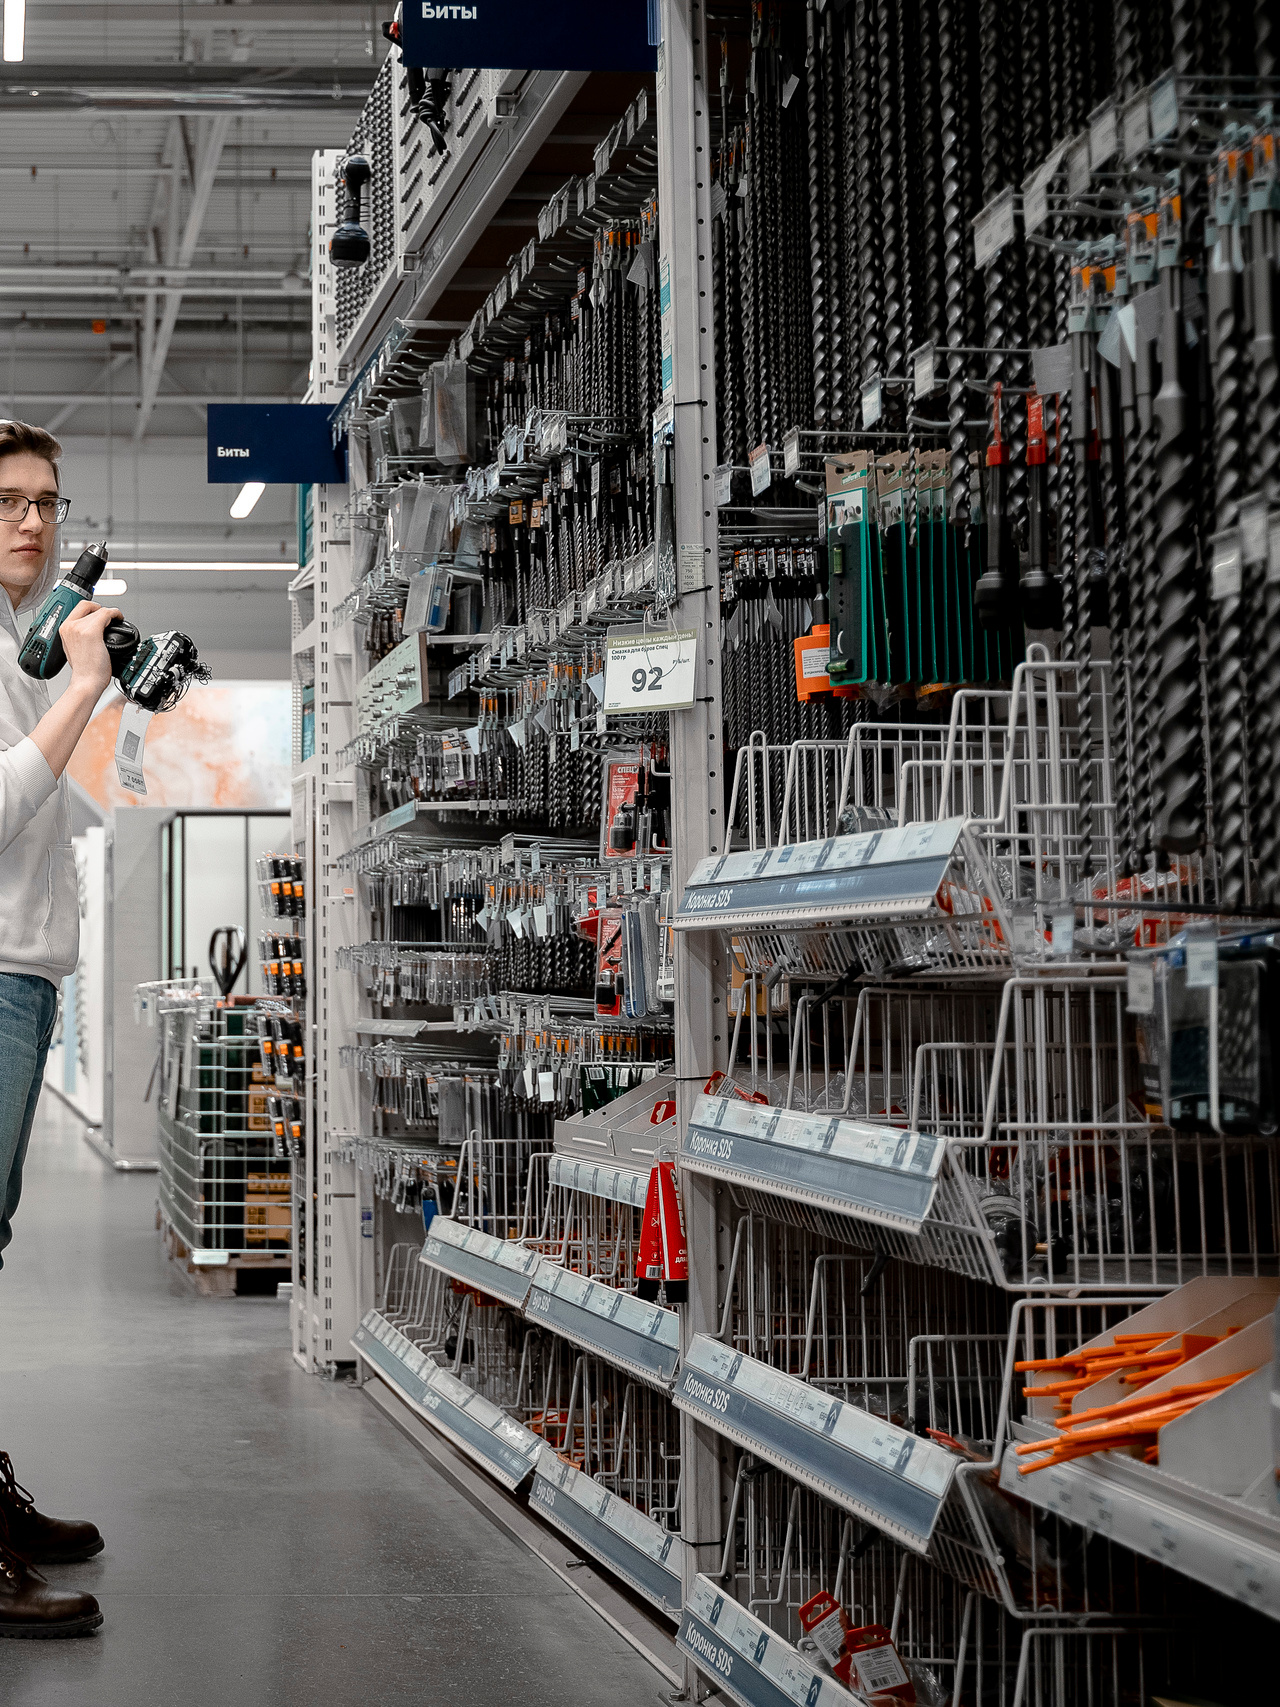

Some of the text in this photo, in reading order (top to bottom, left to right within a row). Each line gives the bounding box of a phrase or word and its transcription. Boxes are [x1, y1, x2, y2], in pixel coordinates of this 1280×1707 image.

[422, 2, 477, 19] Биты
[217, 446, 250, 458] Биты
[653, 633, 676, 643] каждый
[611, 647, 631, 655] Смазка
[631, 667, 663, 693] 92
[685, 888, 734, 912] Коронка SDS
[689, 1130, 734, 1160] Коронка SDS
[683, 1371, 731, 1413] Коронка SDS
[685, 1620, 717, 1664] Коронка
[715, 1647, 734, 1677] SDS
